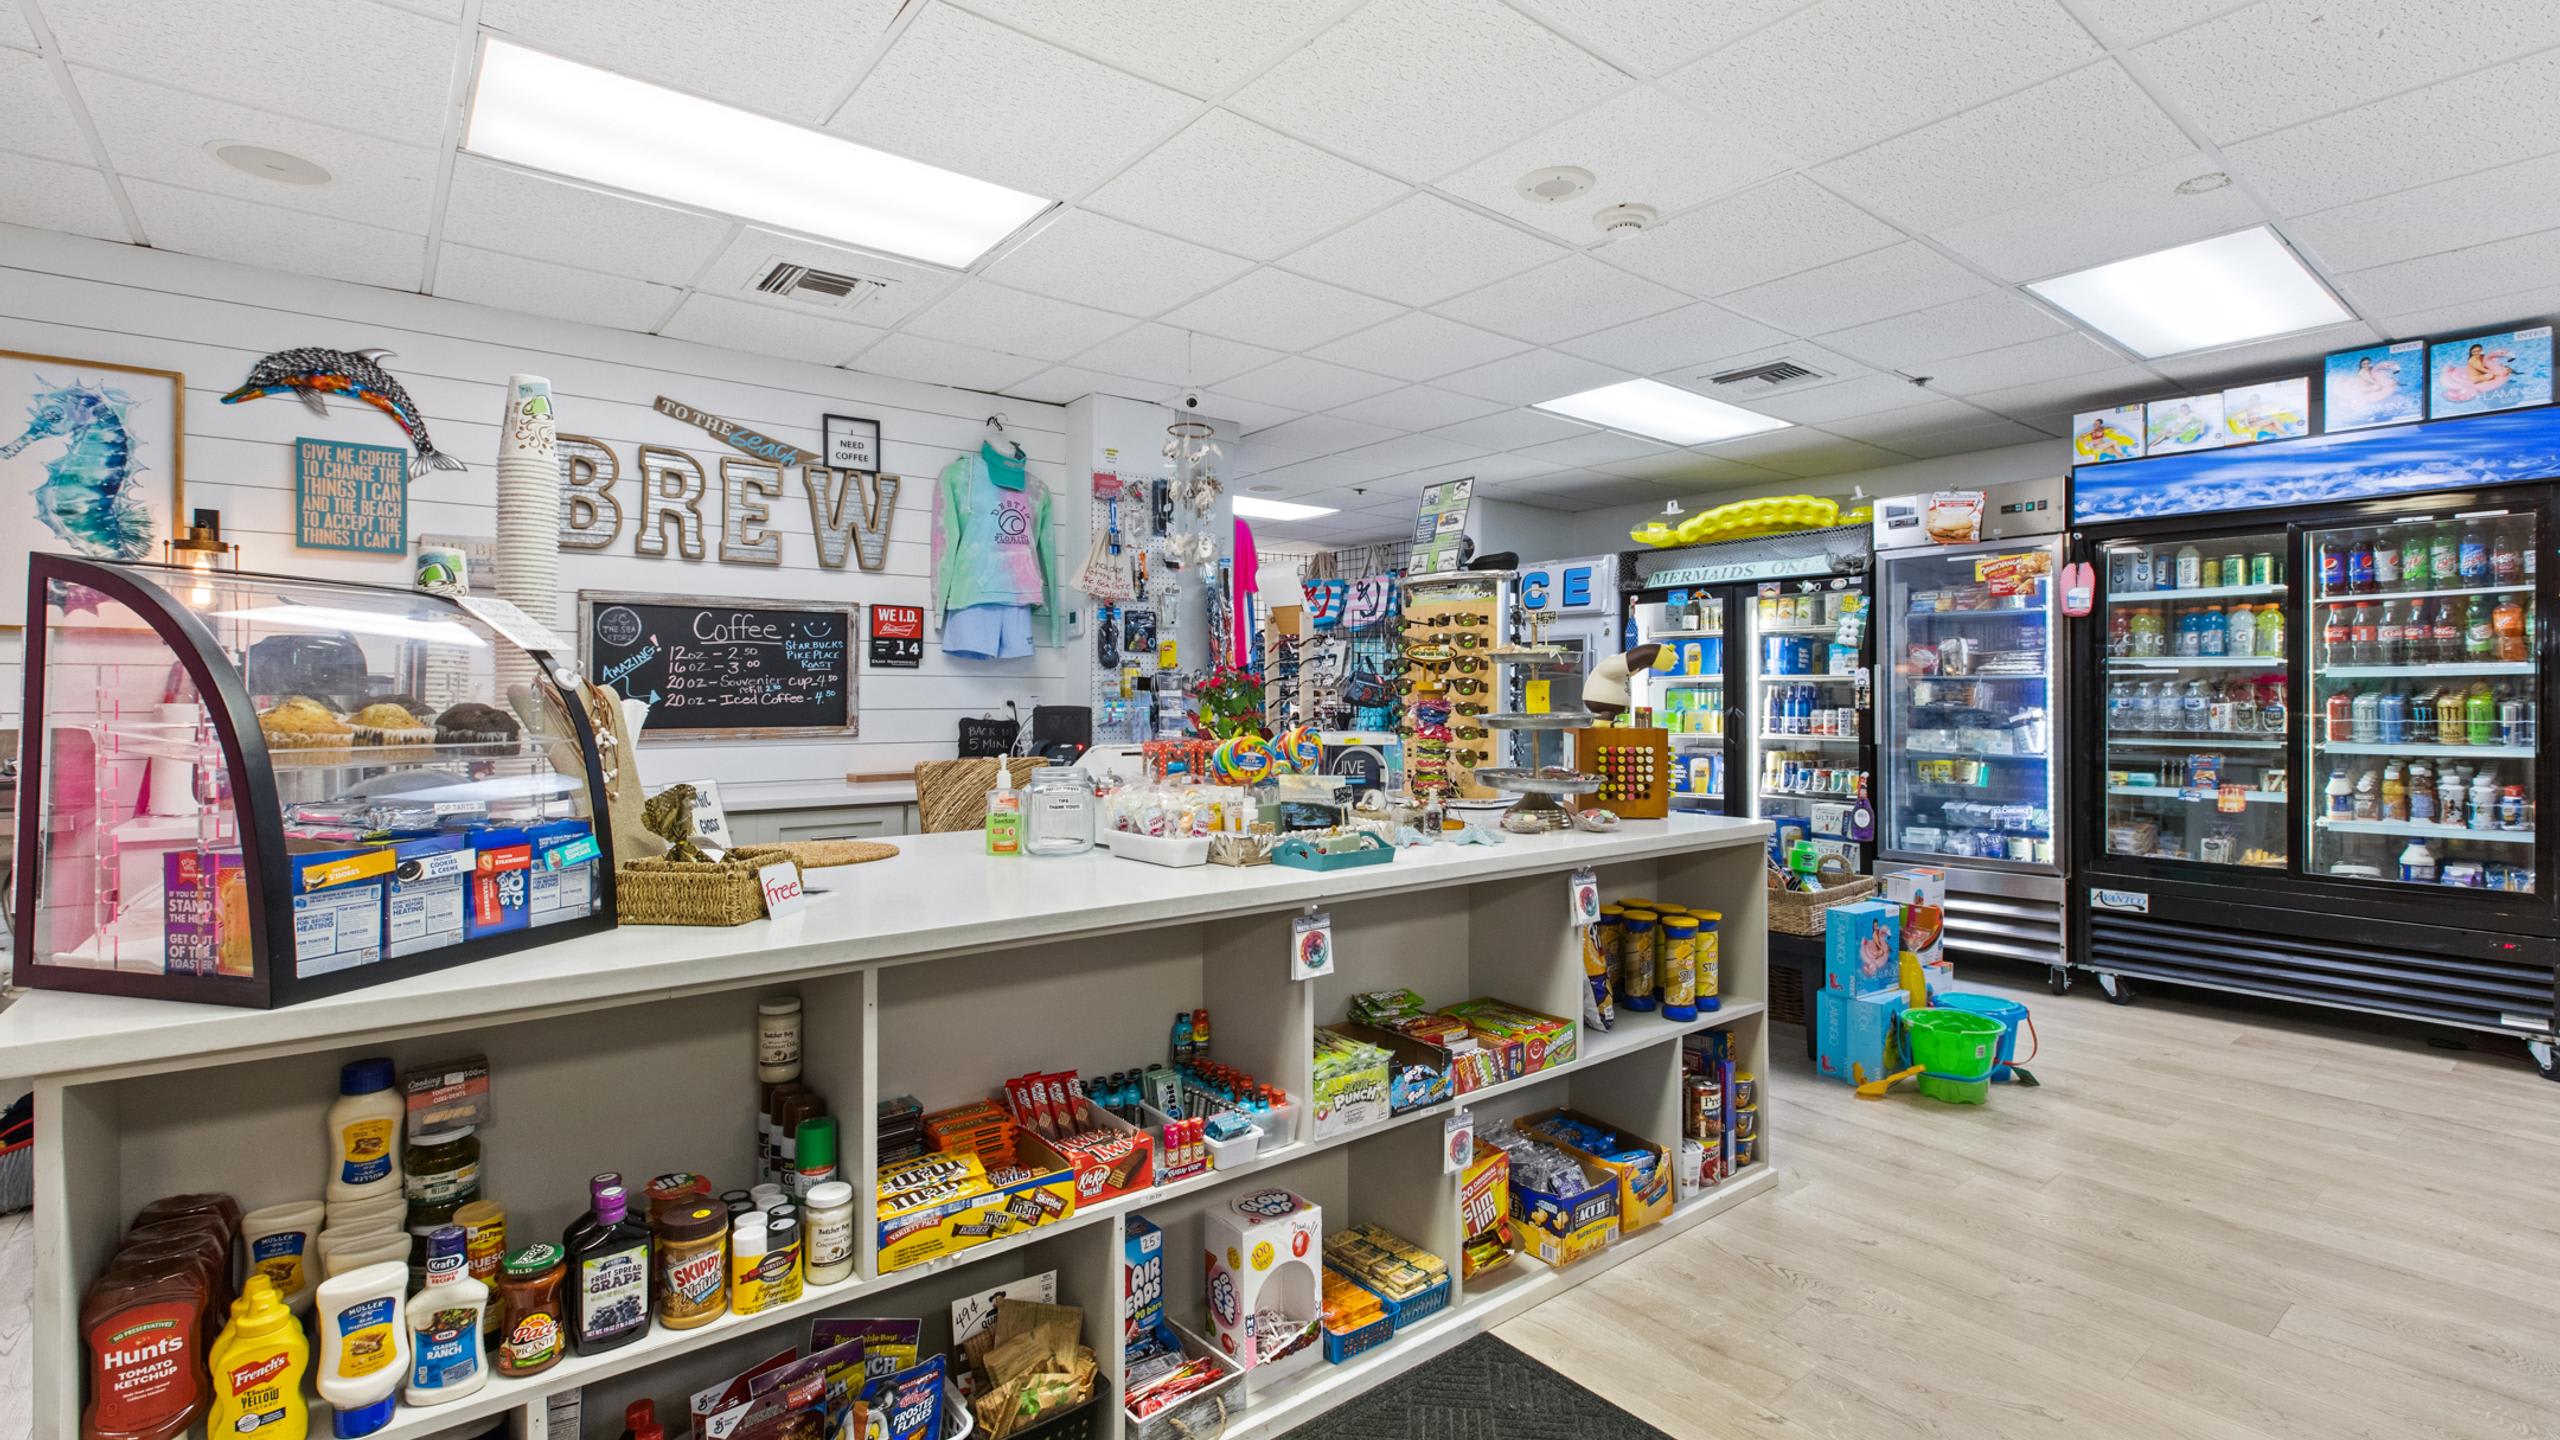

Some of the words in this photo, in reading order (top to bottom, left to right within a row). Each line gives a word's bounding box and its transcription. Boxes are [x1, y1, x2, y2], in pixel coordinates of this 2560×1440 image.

[661, 400, 689, 421] TO
[691, 410, 734, 437] THE
[302, 443, 332, 461] GIVE
[336, 448, 355, 463] ME
[358, 449, 401, 467] COFFEE
[839, 439, 865, 451] NEED
[835, 451, 869, 464] COFFEE
[303, 460, 320, 477] TO
[323, 462, 375, 481] CHANGE
[379, 467, 401, 484] THE
[303, 476, 356, 498] THINGS
[370, 482, 401, 502] CAN
[303, 496, 330, 513] AND
[333, 499, 357, 515] THE
[360, 501, 402, 517] BEACH
[556, 432, 901, 571] BREW
[303, 512, 320, 528] TO
[323, 514, 375, 532] ACCEPT
[378, 517, 401, 533] THE
[303, 527, 350, 546] THINGS
[362, 532, 401, 549] CAN'T
[1652, 564, 1756, 586] MERMAIDS
[878, 608, 897, 622] WE
[898, 609, 918, 623] I.D.
[786, 651, 811, 660] PIKE
[812, 651, 840, 659] PLACE
[801, 661, 834, 669] ROAST
[720, 694, 758, 706] Iced
[760, 693, 804, 706] Coffee
[968, 726, 996, 737] BACK
[969, 739, 978, 750] 5
[1337, 759, 1366, 775] JIVE
[430, 858, 458, 869] COOKIES
[393, 905, 425, 917] HEATING
[2093, 890, 2147, 911] AVANTCO
[169, 914, 186, 923] THE
[296, 921, 335, 933] HEATING
[169, 934, 188, 944] GET
[169, 945, 187, 958] OF
[406, 1075, 442, 1090] Cooking
[1333, 1086, 1378, 1113] PUNCH
[1239, 1193, 1291, 1213] BLOW
[1258, 1201, 1295, 1217] POP
[1464, 1190, 1494, 1224] slim
[1578, 1204, 1595, 1221] ACT
[920, 1218, 939, 1230] PACK
[430, 1258, 455, 1270] Kraft
[590, 1270, 612, 1285] FRUIT
[613, 1264, 643, 1276] SPREAD
[673, 1253, 721, 1288] SKIPPY
[590, 1271, 642, 1294] GRAPE
[1131, 1256, 1161, 1294] AIR
[512, 1320, 558, 1344] Pace
[426, 1345, 463, 1361] RANCH
[114, 1366, 178, 1391] KETCHUP
[118, 1359, 173, 1381] TOMATO
[234, 1356, 286, 1388] French's
[240, 1388, 279, 1409] YELLOW
[893, 1394, 936, 1426] FROSTED
[896, 1407, 933, 1436] FLAKES
